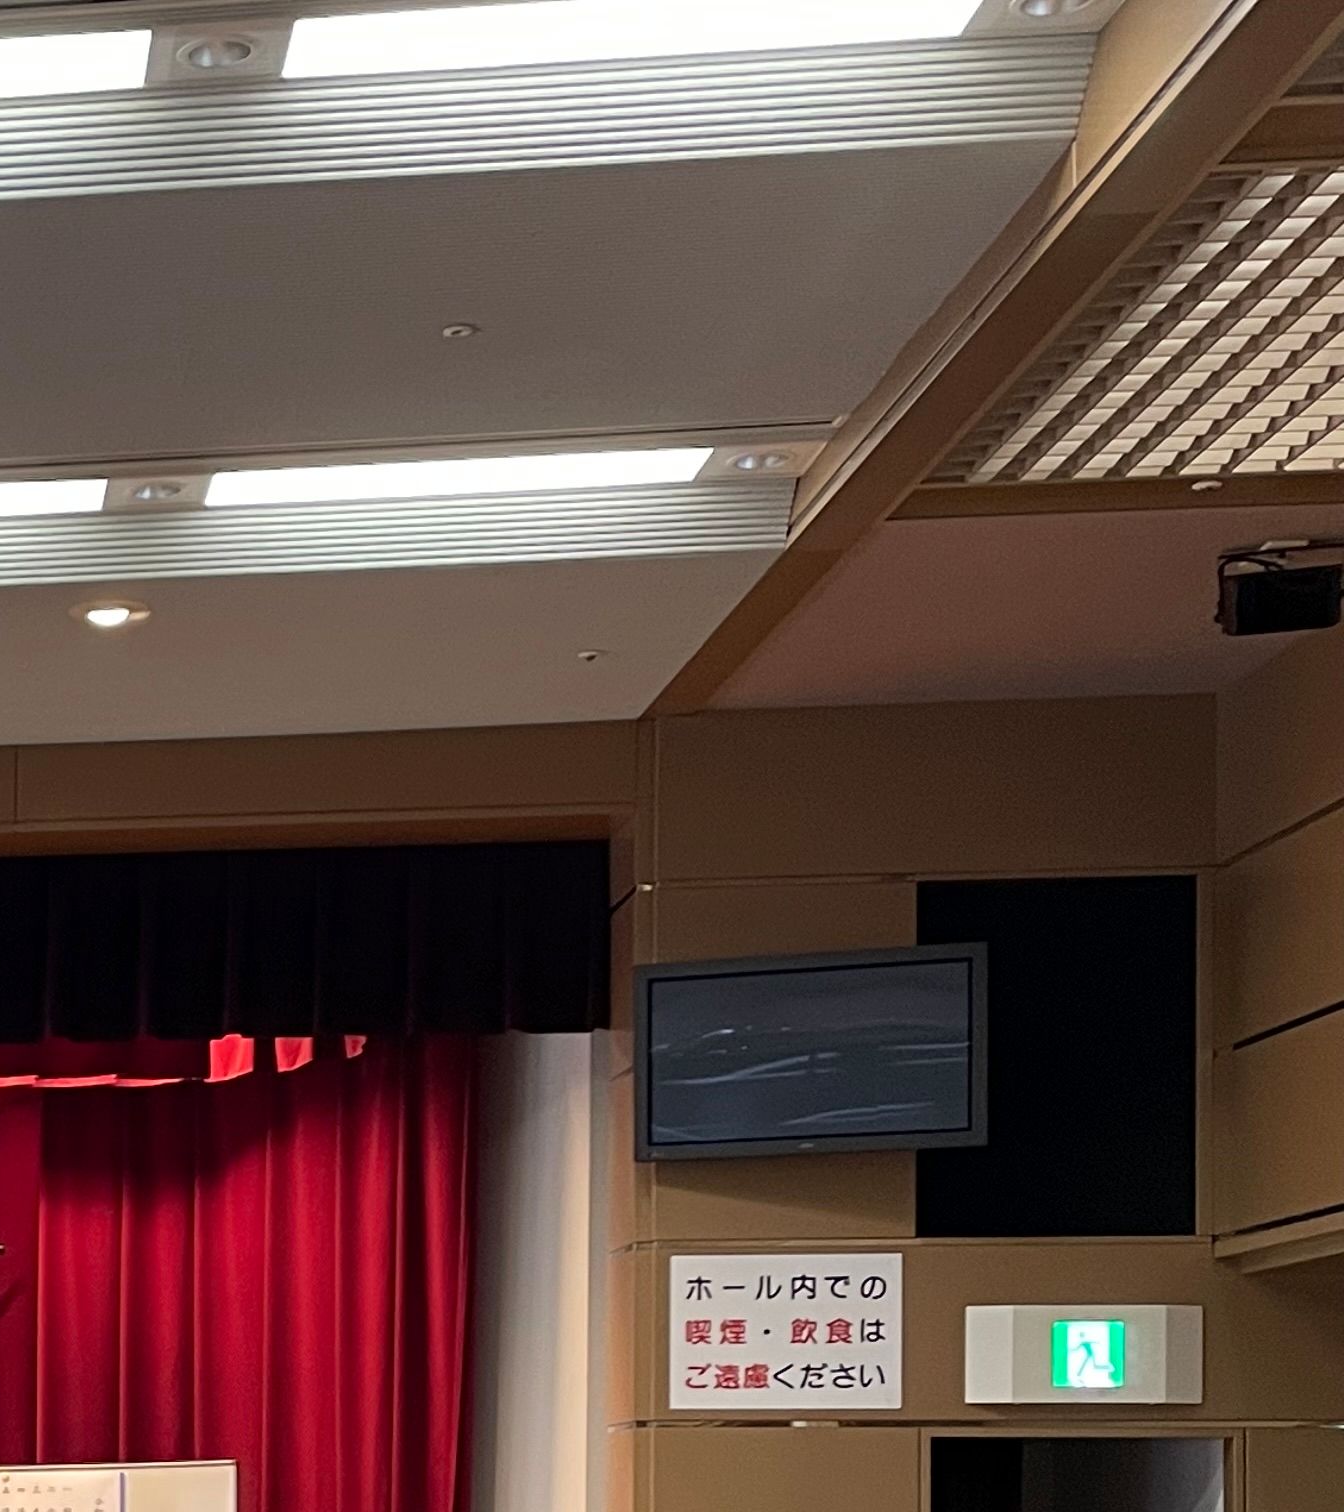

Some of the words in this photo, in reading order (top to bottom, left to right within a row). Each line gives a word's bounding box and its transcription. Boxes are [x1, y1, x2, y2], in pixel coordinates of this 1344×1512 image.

[684, 1273, 888, 1302] ホール内での
[684, 1317, 887, 1346] 喫煙・飲食は
[684, 1361, 887, 1390] ご遠慮ください
